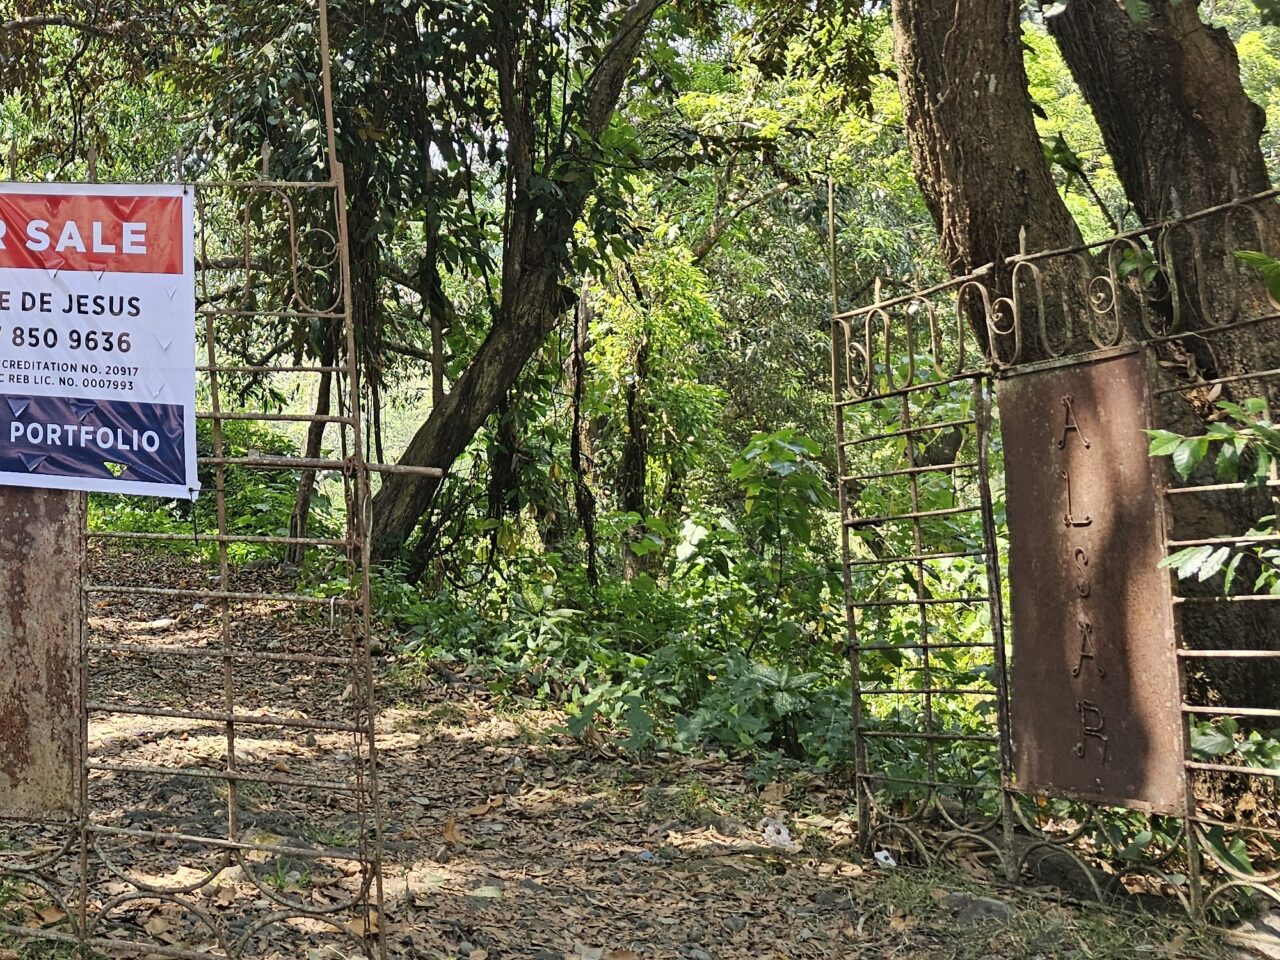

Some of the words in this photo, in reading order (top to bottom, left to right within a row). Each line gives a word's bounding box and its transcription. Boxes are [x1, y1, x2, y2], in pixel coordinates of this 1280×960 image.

[25, 220, 147, 254] SALE
[21, 291, 52, 313] DE
[62, 294, 141, 317] JESUS
[11, 326, 58, 349] 850
[68, 329, 132, 353] 9636
[8, 373, 30, 384] REB
[33, 375, 55, 386] LIC.
[58, 376, 79, 388] NO.
[82, 378, 134, 391] 0007993
[81, 364, 102, 375] NO.
[105, 365, 139, 377] 20917
[10, 420, 160, 452] PORTFOLIO
[1056, 392, 1108, 766] ALSAR
